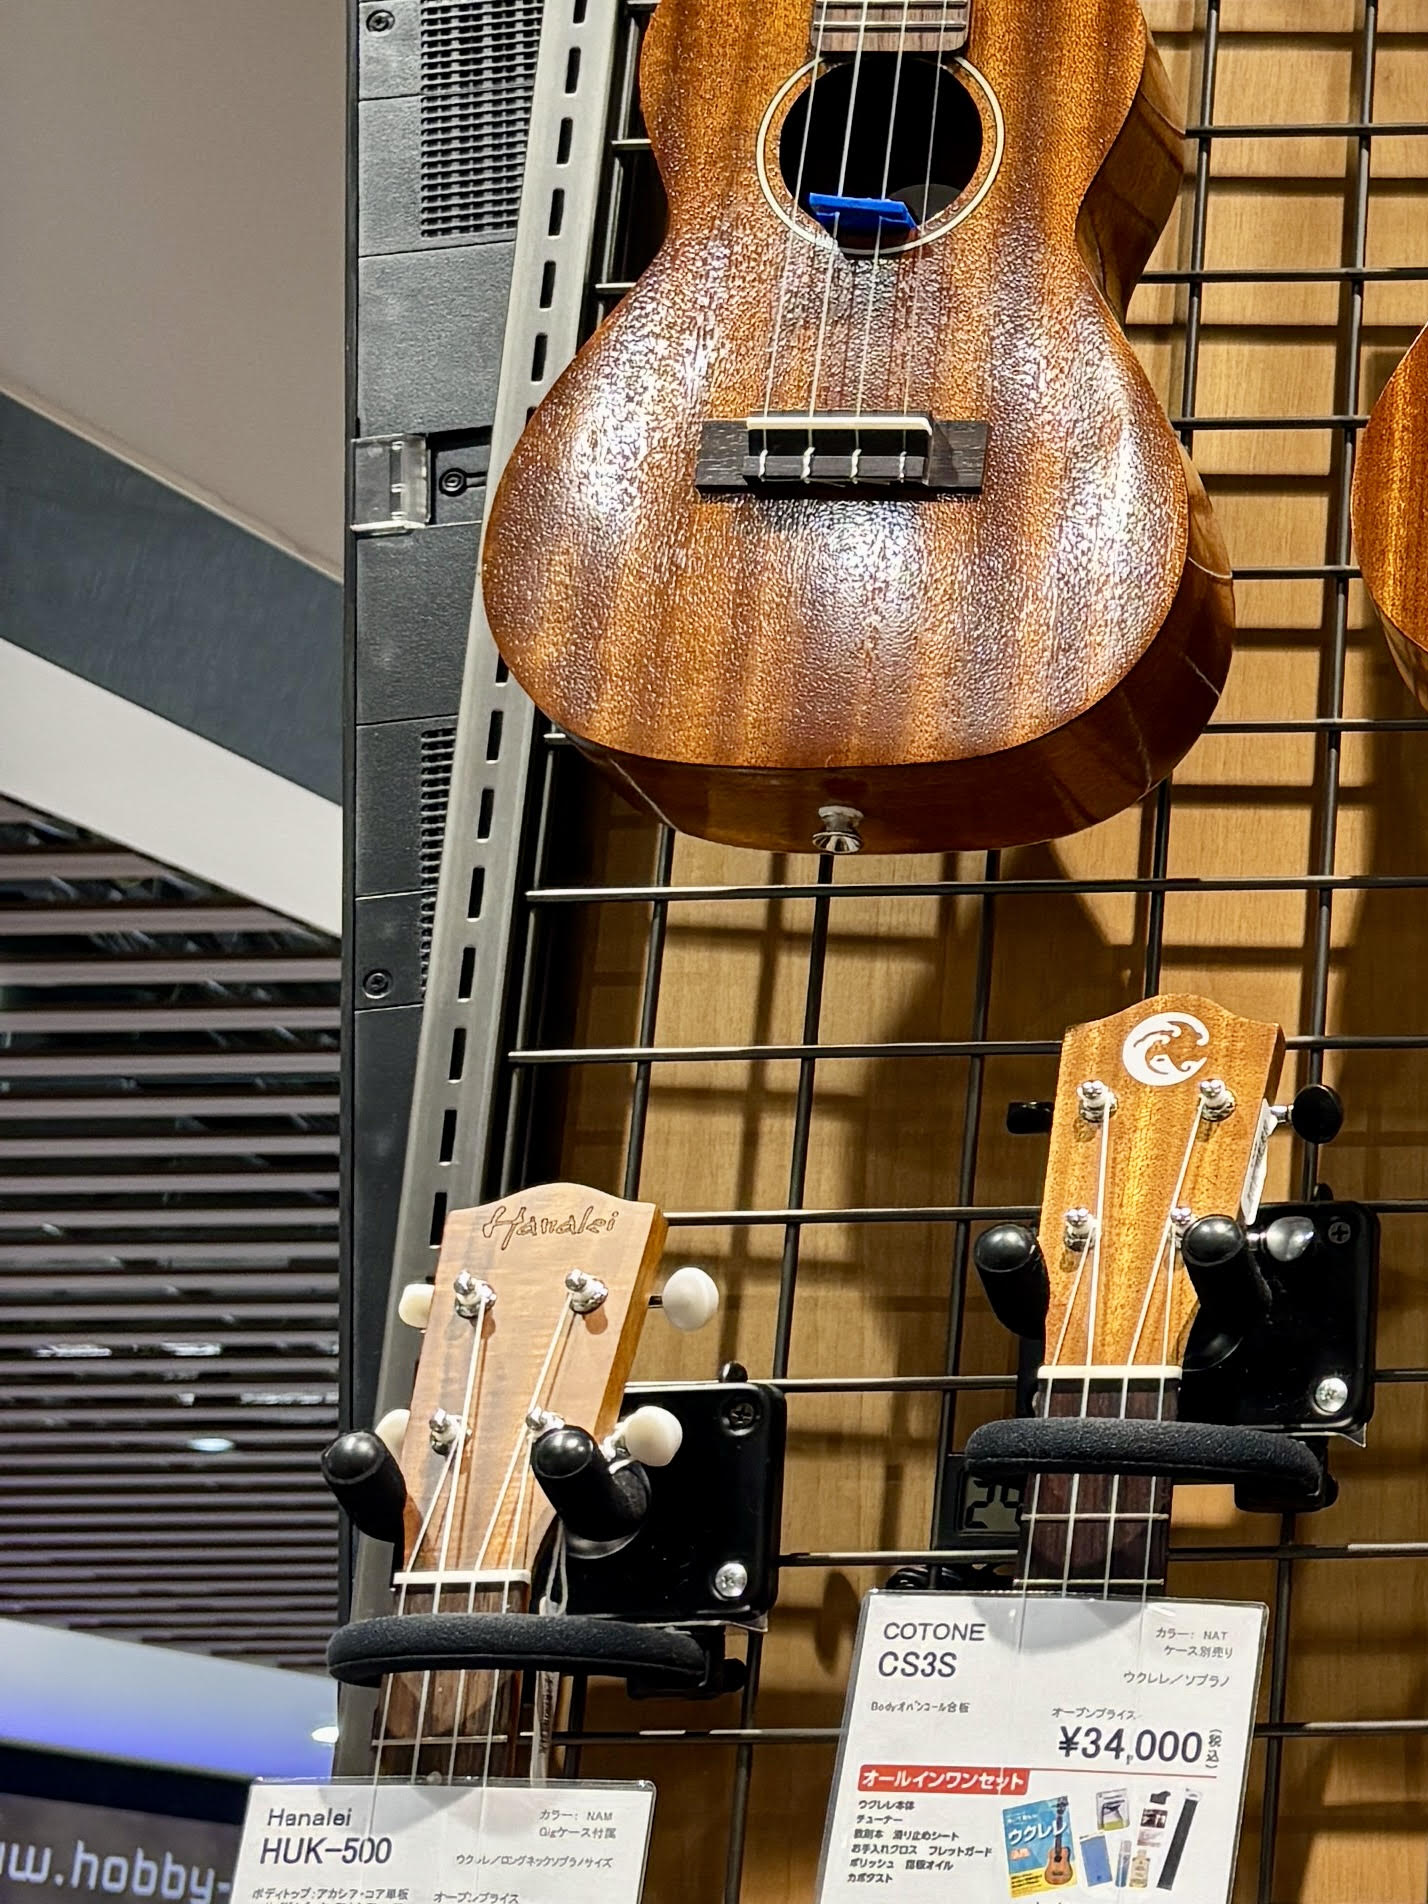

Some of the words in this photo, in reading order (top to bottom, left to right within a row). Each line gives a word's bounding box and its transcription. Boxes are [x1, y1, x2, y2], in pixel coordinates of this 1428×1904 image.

[481, 1204, 620, 1251] Hanalei
[882, 1621, 986, 1642] COTONE
[1202, 1629, 1228, 1640] NAT
[1162, 1645, 1234, 1659] ケース別売り
[876, 1649, 958, 1679] CS3S
[1050, 1706, 1137, 1721] オープンプライス
[1054, 1725, 1204, 1766] ¥34,000
[861, 1767, 1025, 1793] オールインワンセット
[266, 1806, 353, 1828] Hanalei
[586, 1811, 612, 1821] NAM
[258, 1835, 394, 1867] HUK-500
